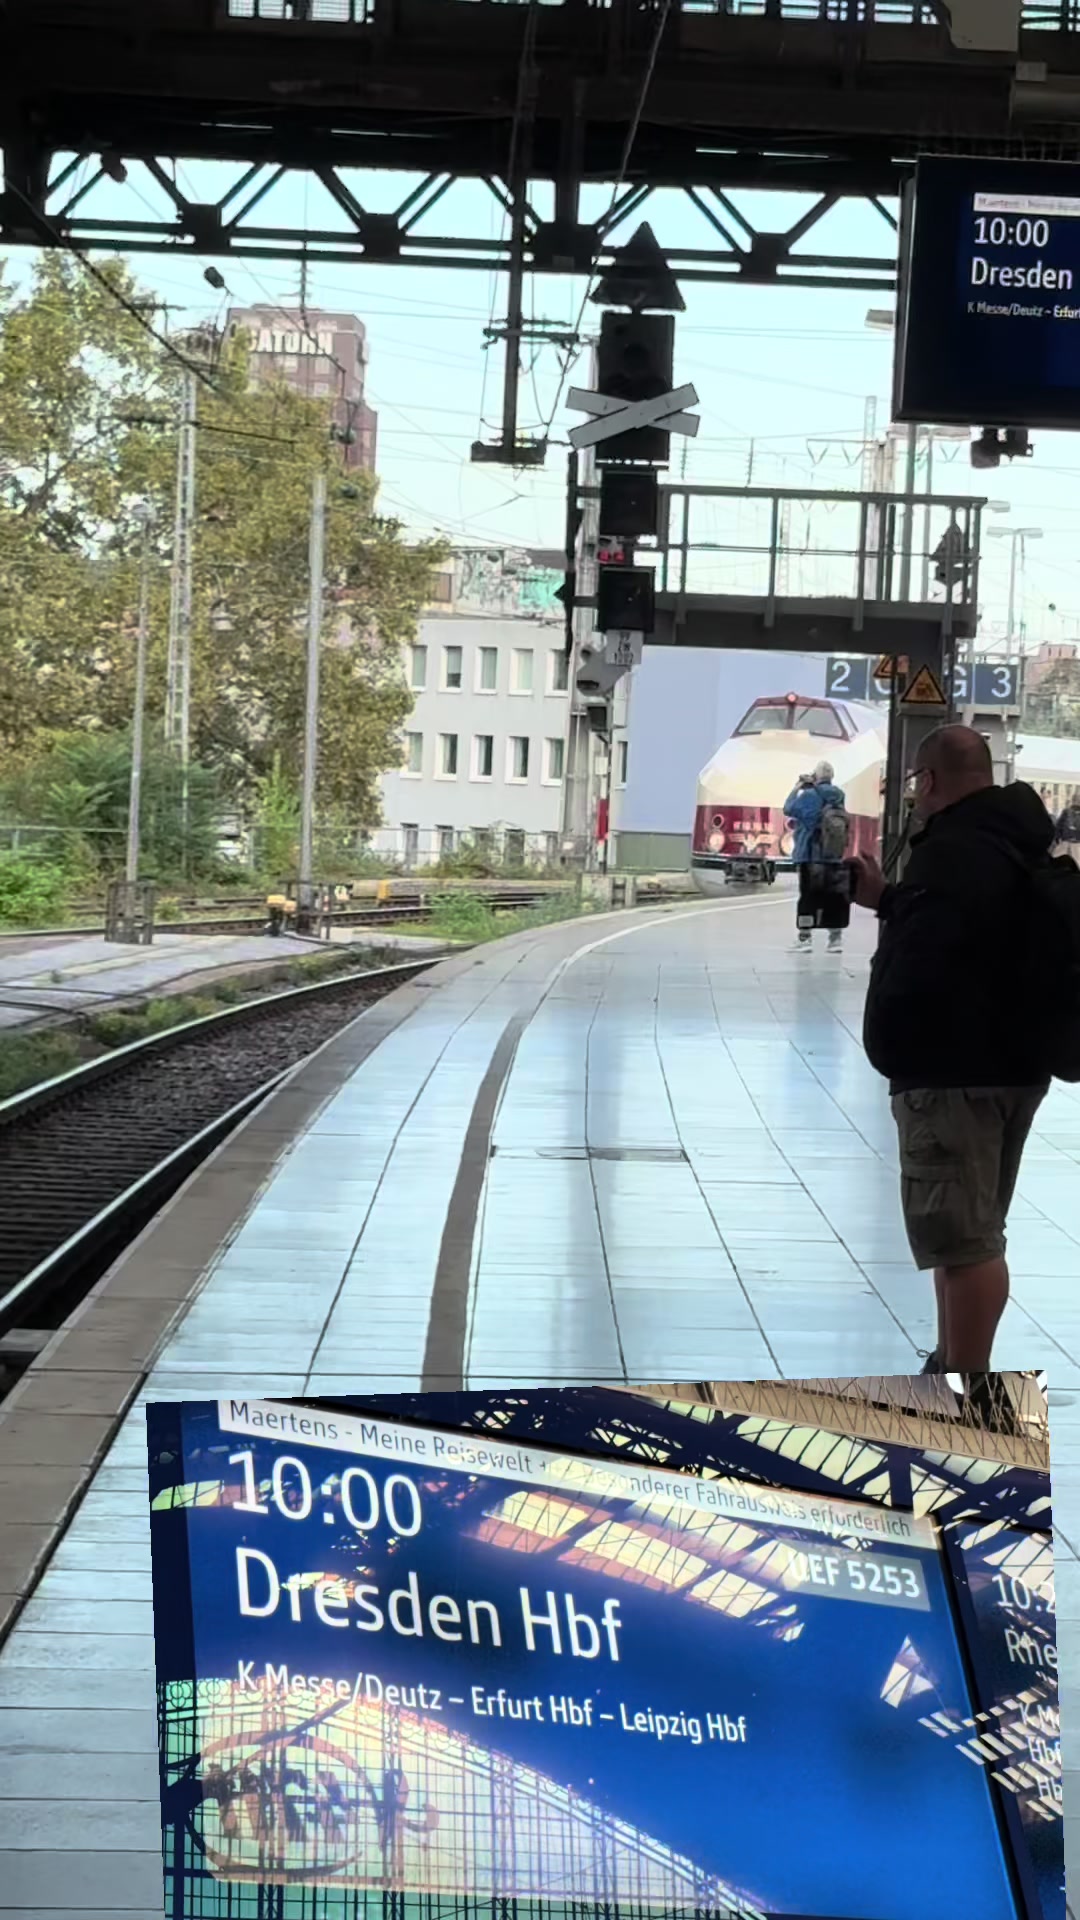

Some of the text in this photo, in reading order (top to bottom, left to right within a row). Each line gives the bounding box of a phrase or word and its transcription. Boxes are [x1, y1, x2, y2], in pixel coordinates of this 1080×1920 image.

[974, 216, 1049, 247] 10:00
[971, 256, 1073, 290] Dresden
[967, 301, 975, 313] K
[1053, 303, 1080, 319] Erfur
[830, 660, 850, 692] 2
[991, 666, 1012, 698] 3
[229, 1399, 338, 1440] Maertens
[360, 1423, 427, 1455] Meine
[433, 1435, 533, 1474] Reisewelt
[227, 1450, 423, 1538] 10:00
[846, 1559, 920, 1598] 5253
[235, 1546, 622, 1662] Dresden Hbf
[237, 1659, 258, 1693] K
[264, 1663, 443, 1711] Messe/Deutz
[470, 1685, 544, 1721] Erfurt
[549, 1695, 593, 1726] Hbf
[619, 1703, 702, 1745] Leipzig
[706, 1712, 747, 1742] Hbf
